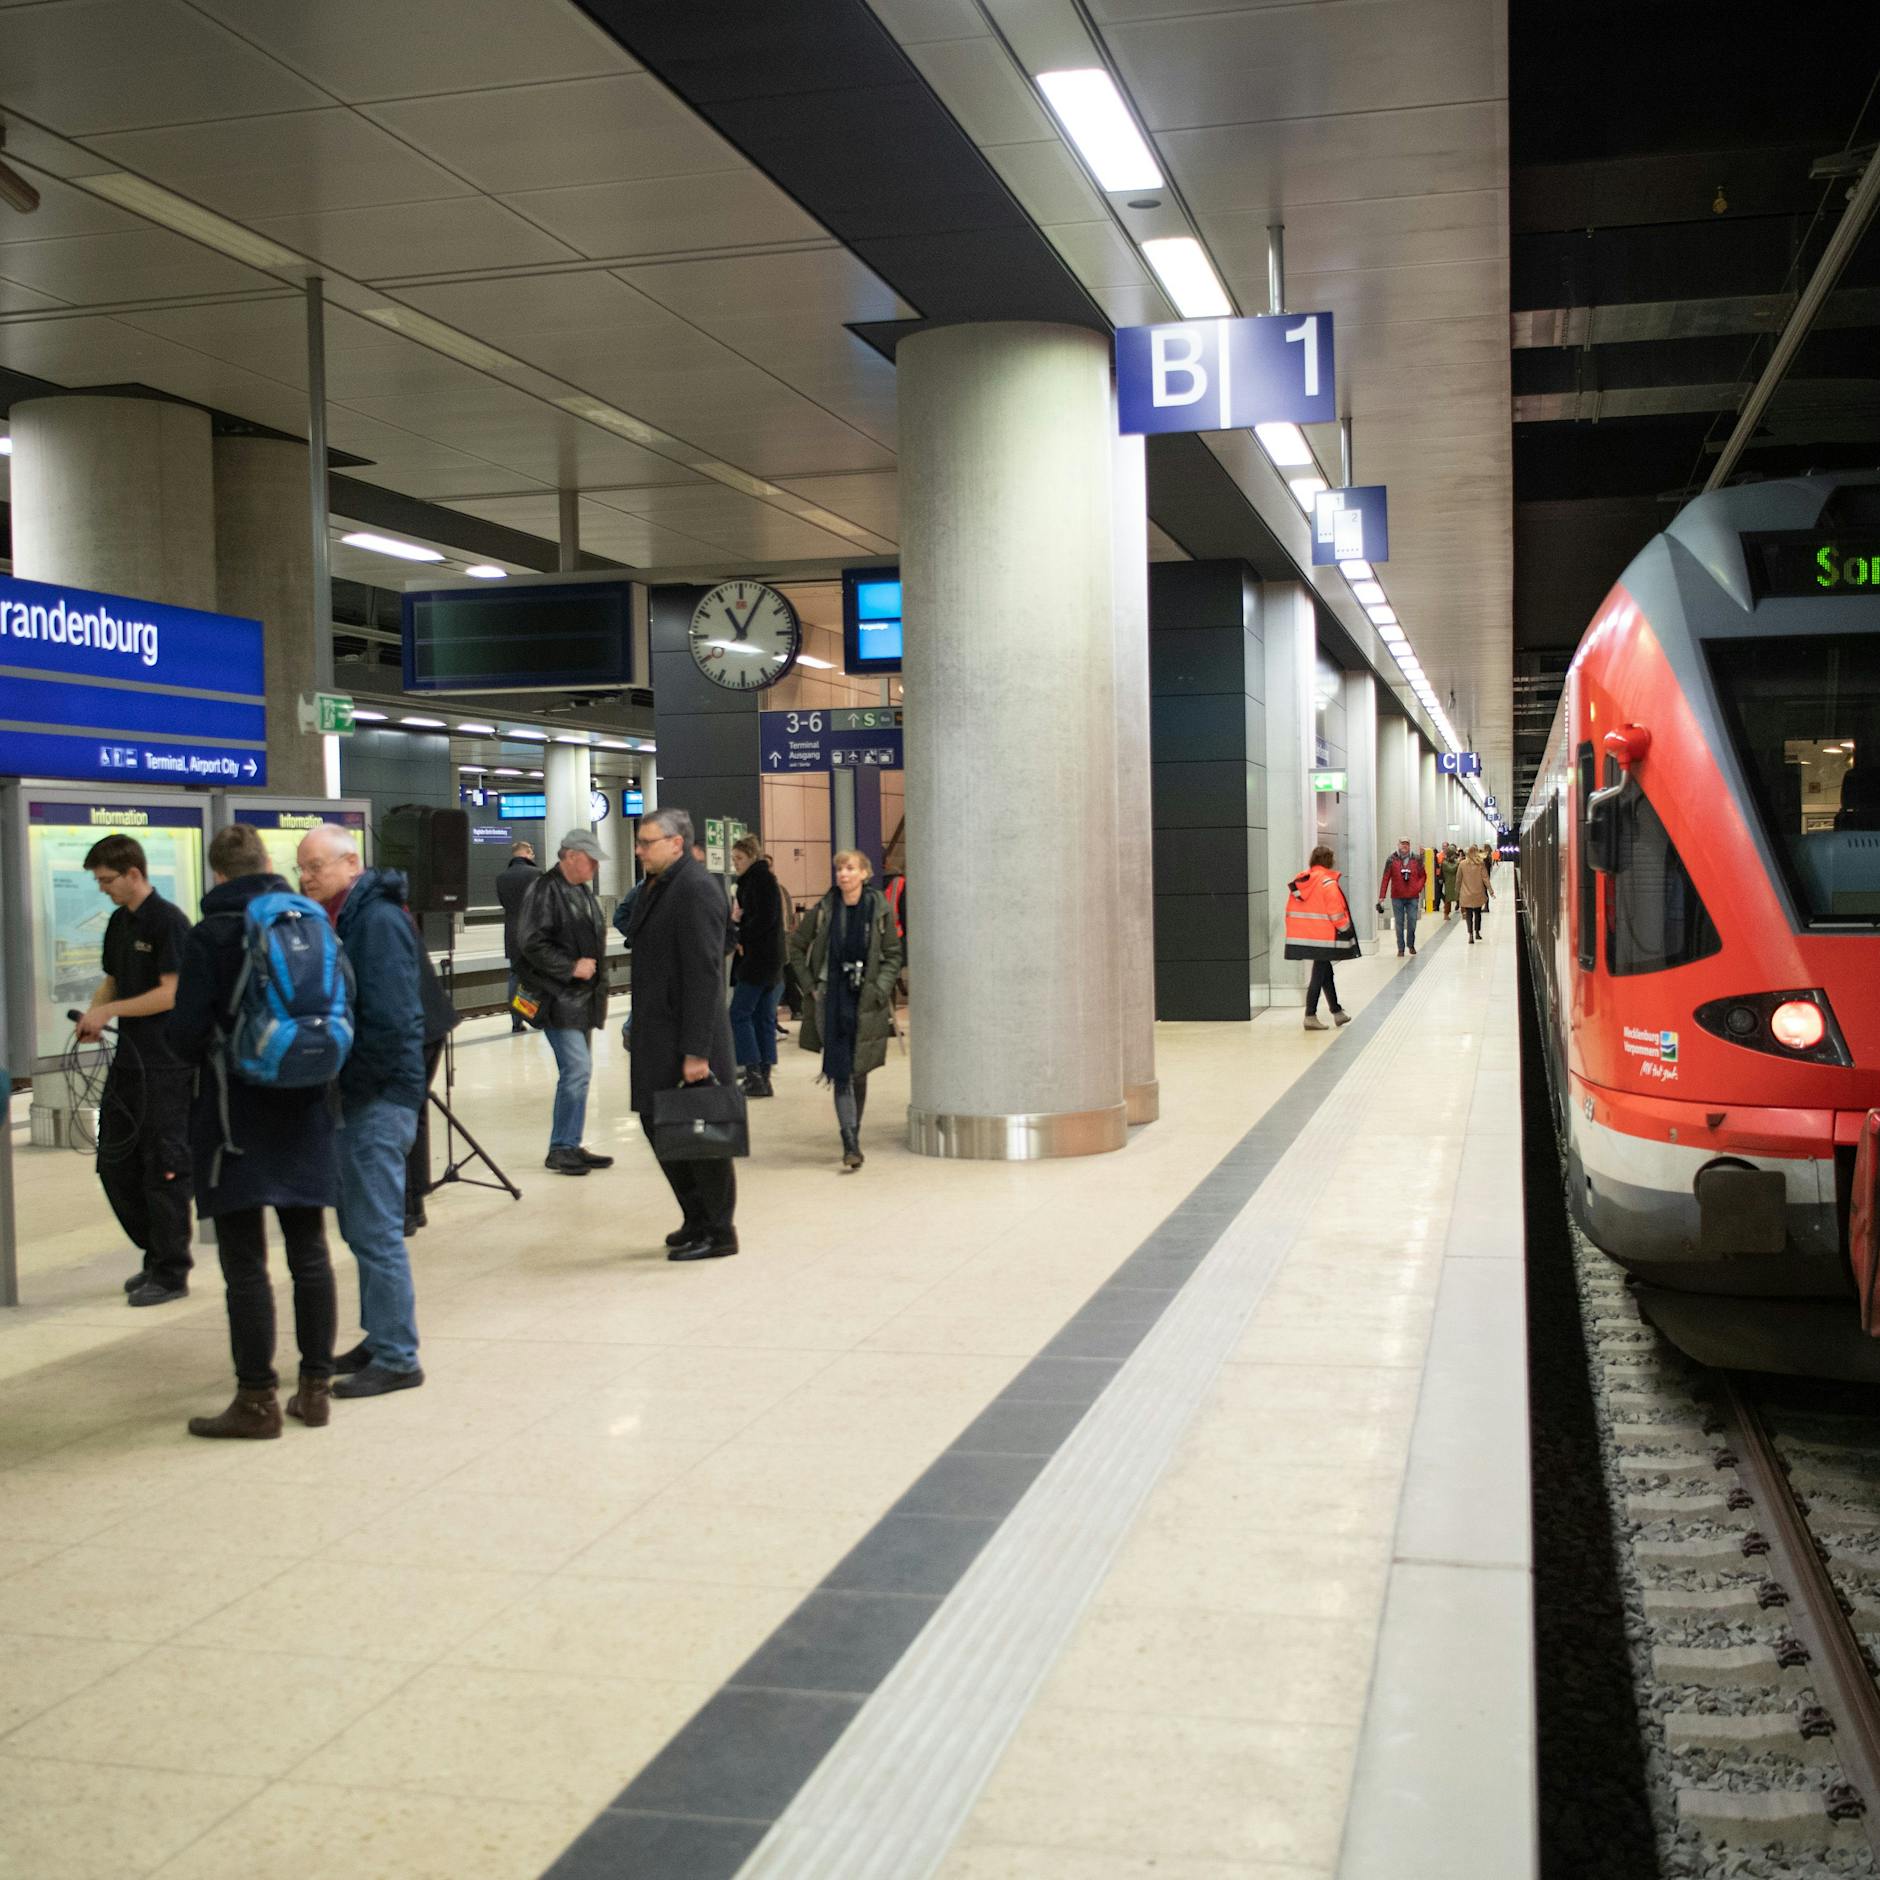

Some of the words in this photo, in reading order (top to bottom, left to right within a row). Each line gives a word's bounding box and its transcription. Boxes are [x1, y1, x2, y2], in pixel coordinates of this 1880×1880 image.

[1150, 328, 1208, 408] B
[1285, 316, 1319, 396] 1
[786, 711, 822, 733] 3-6
[788, 741, 820, 750] Terminal
[145, 752, 189, 774] Terminal,
[190, 757, 221, 777] Airport
[221, 758, 240, 778] City
[788, 751, 821, 761] Ausgang
[1443, 753, 1456, 769] C
[1469, 752, 1477, 769] 1
[90, 807, 149, 826] Information
